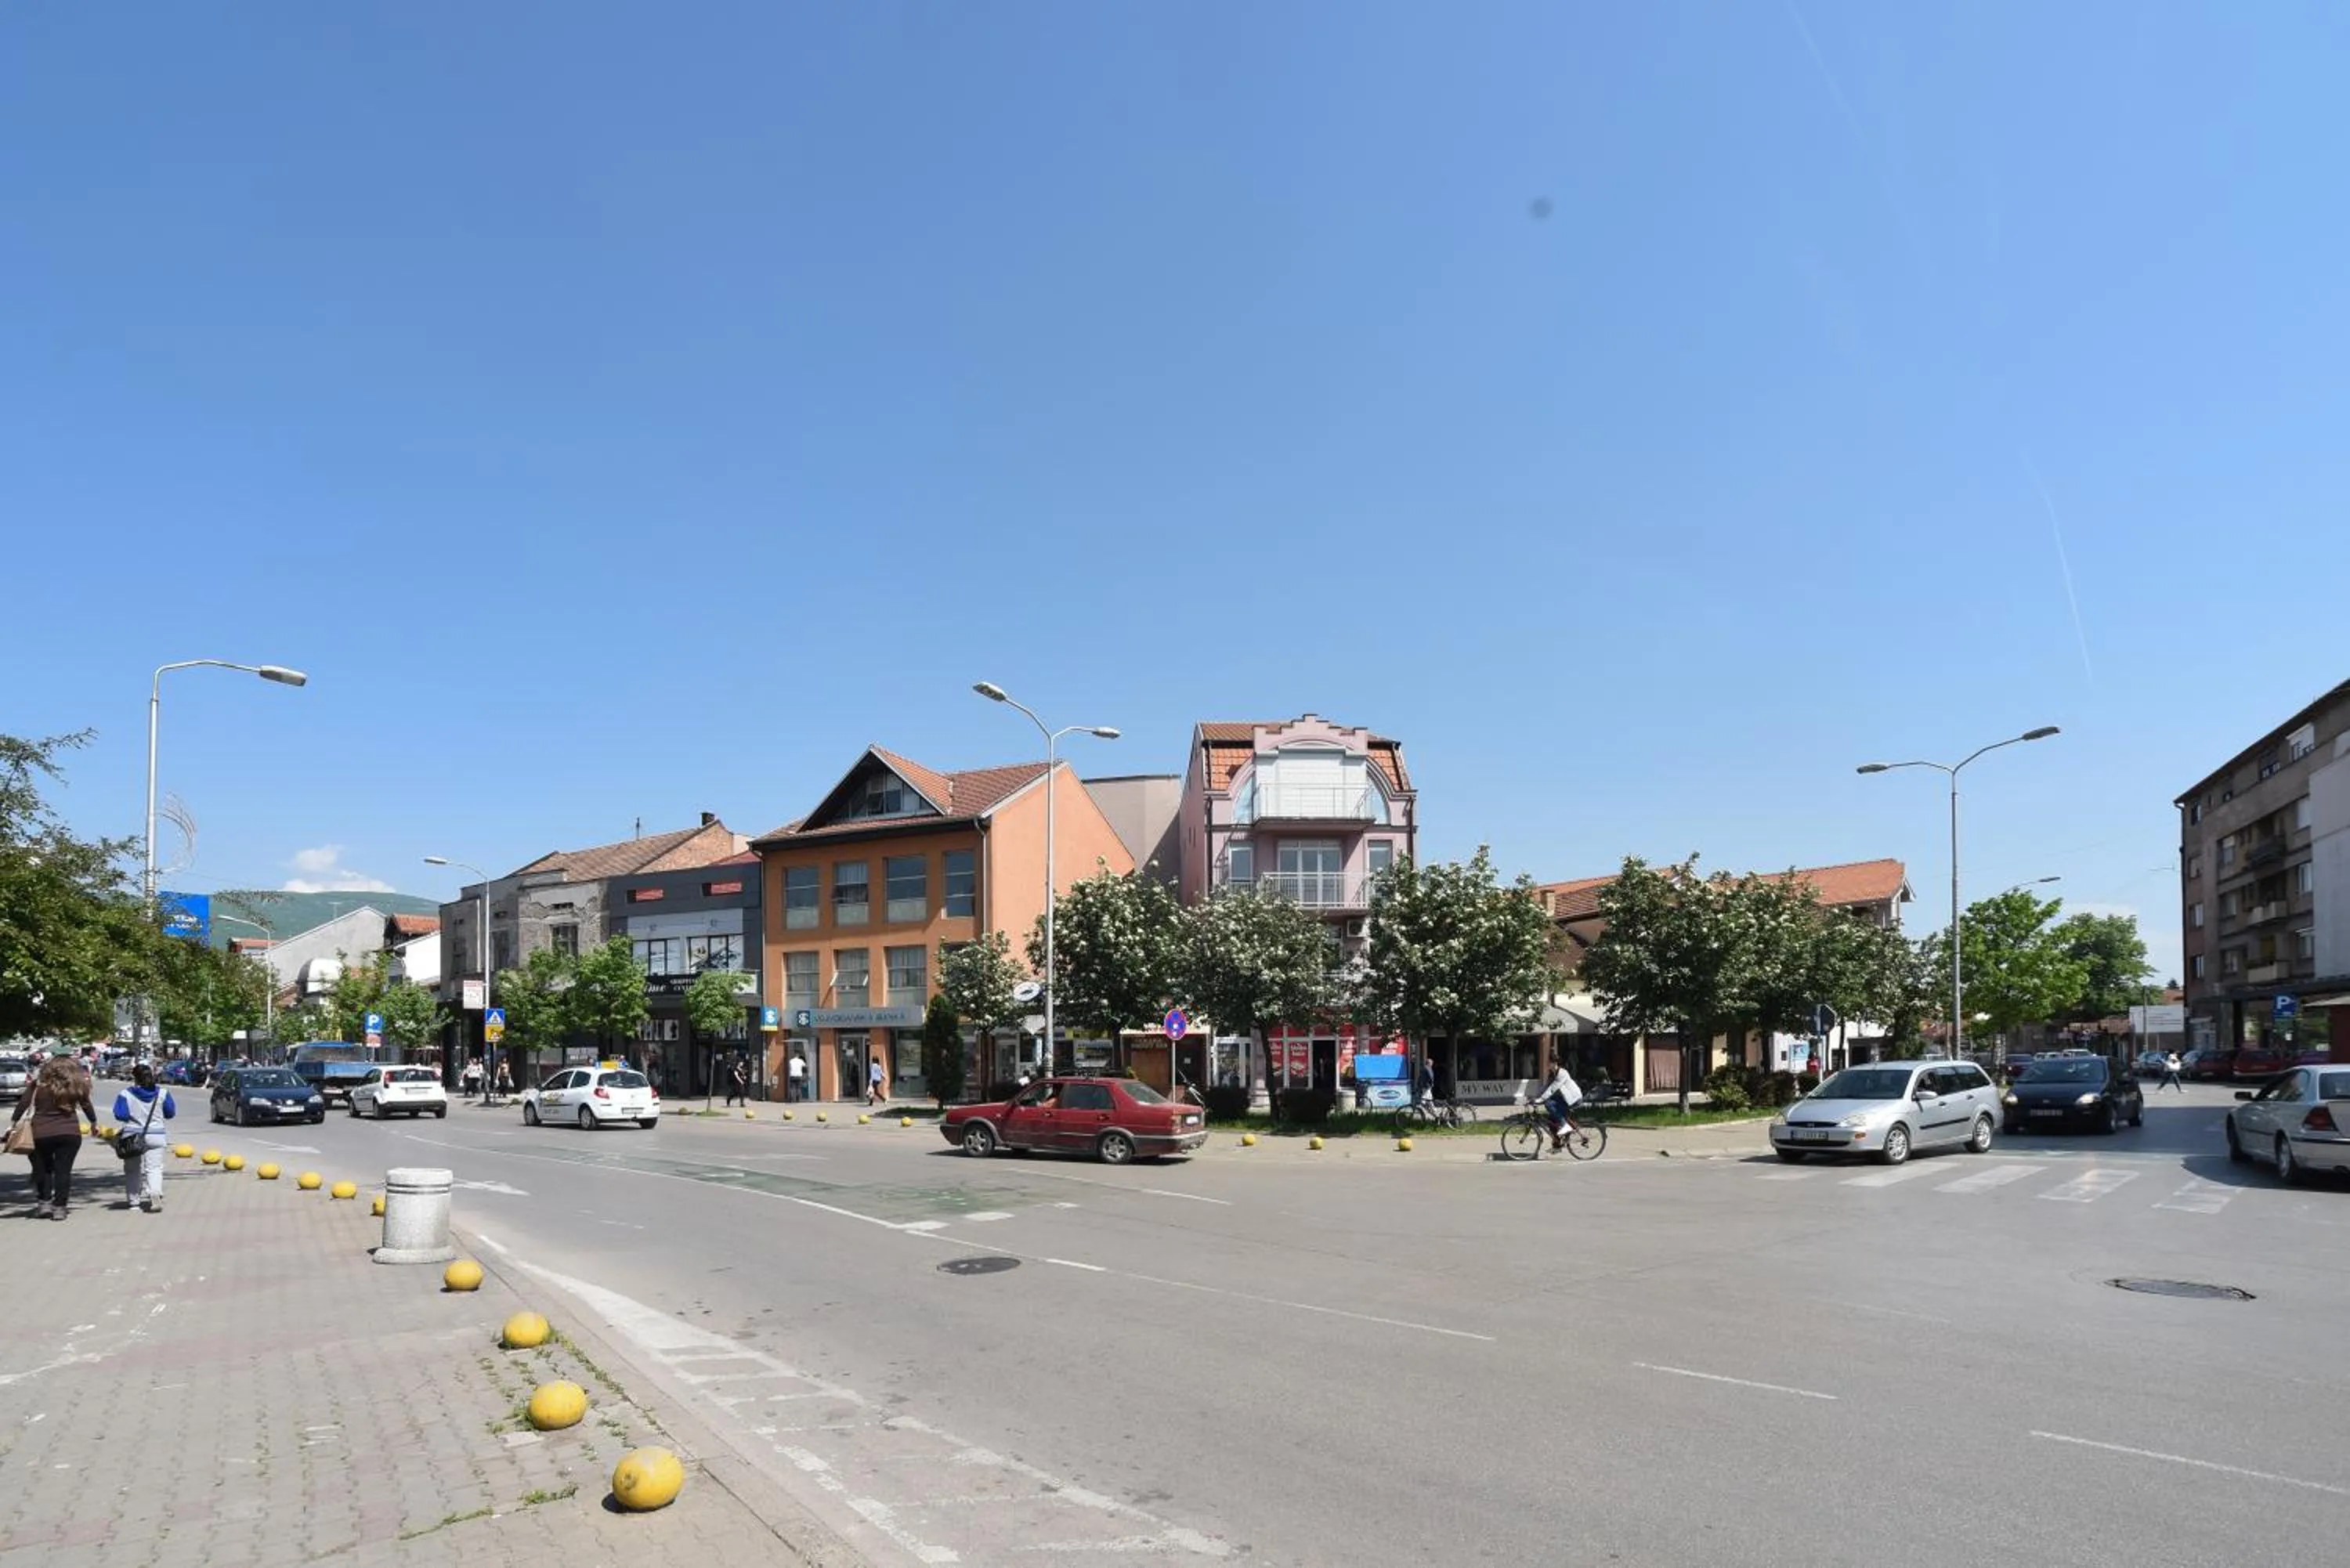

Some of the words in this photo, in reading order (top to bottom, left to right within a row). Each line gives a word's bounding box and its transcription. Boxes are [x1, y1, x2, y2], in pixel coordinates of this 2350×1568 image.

[2277, 995, 2290, 1010] P
[368, 1014, 380, 1027] P
[1462, 1084, 1480, 1094] MY
[1483, 1083, 1505, 1093] WAY
